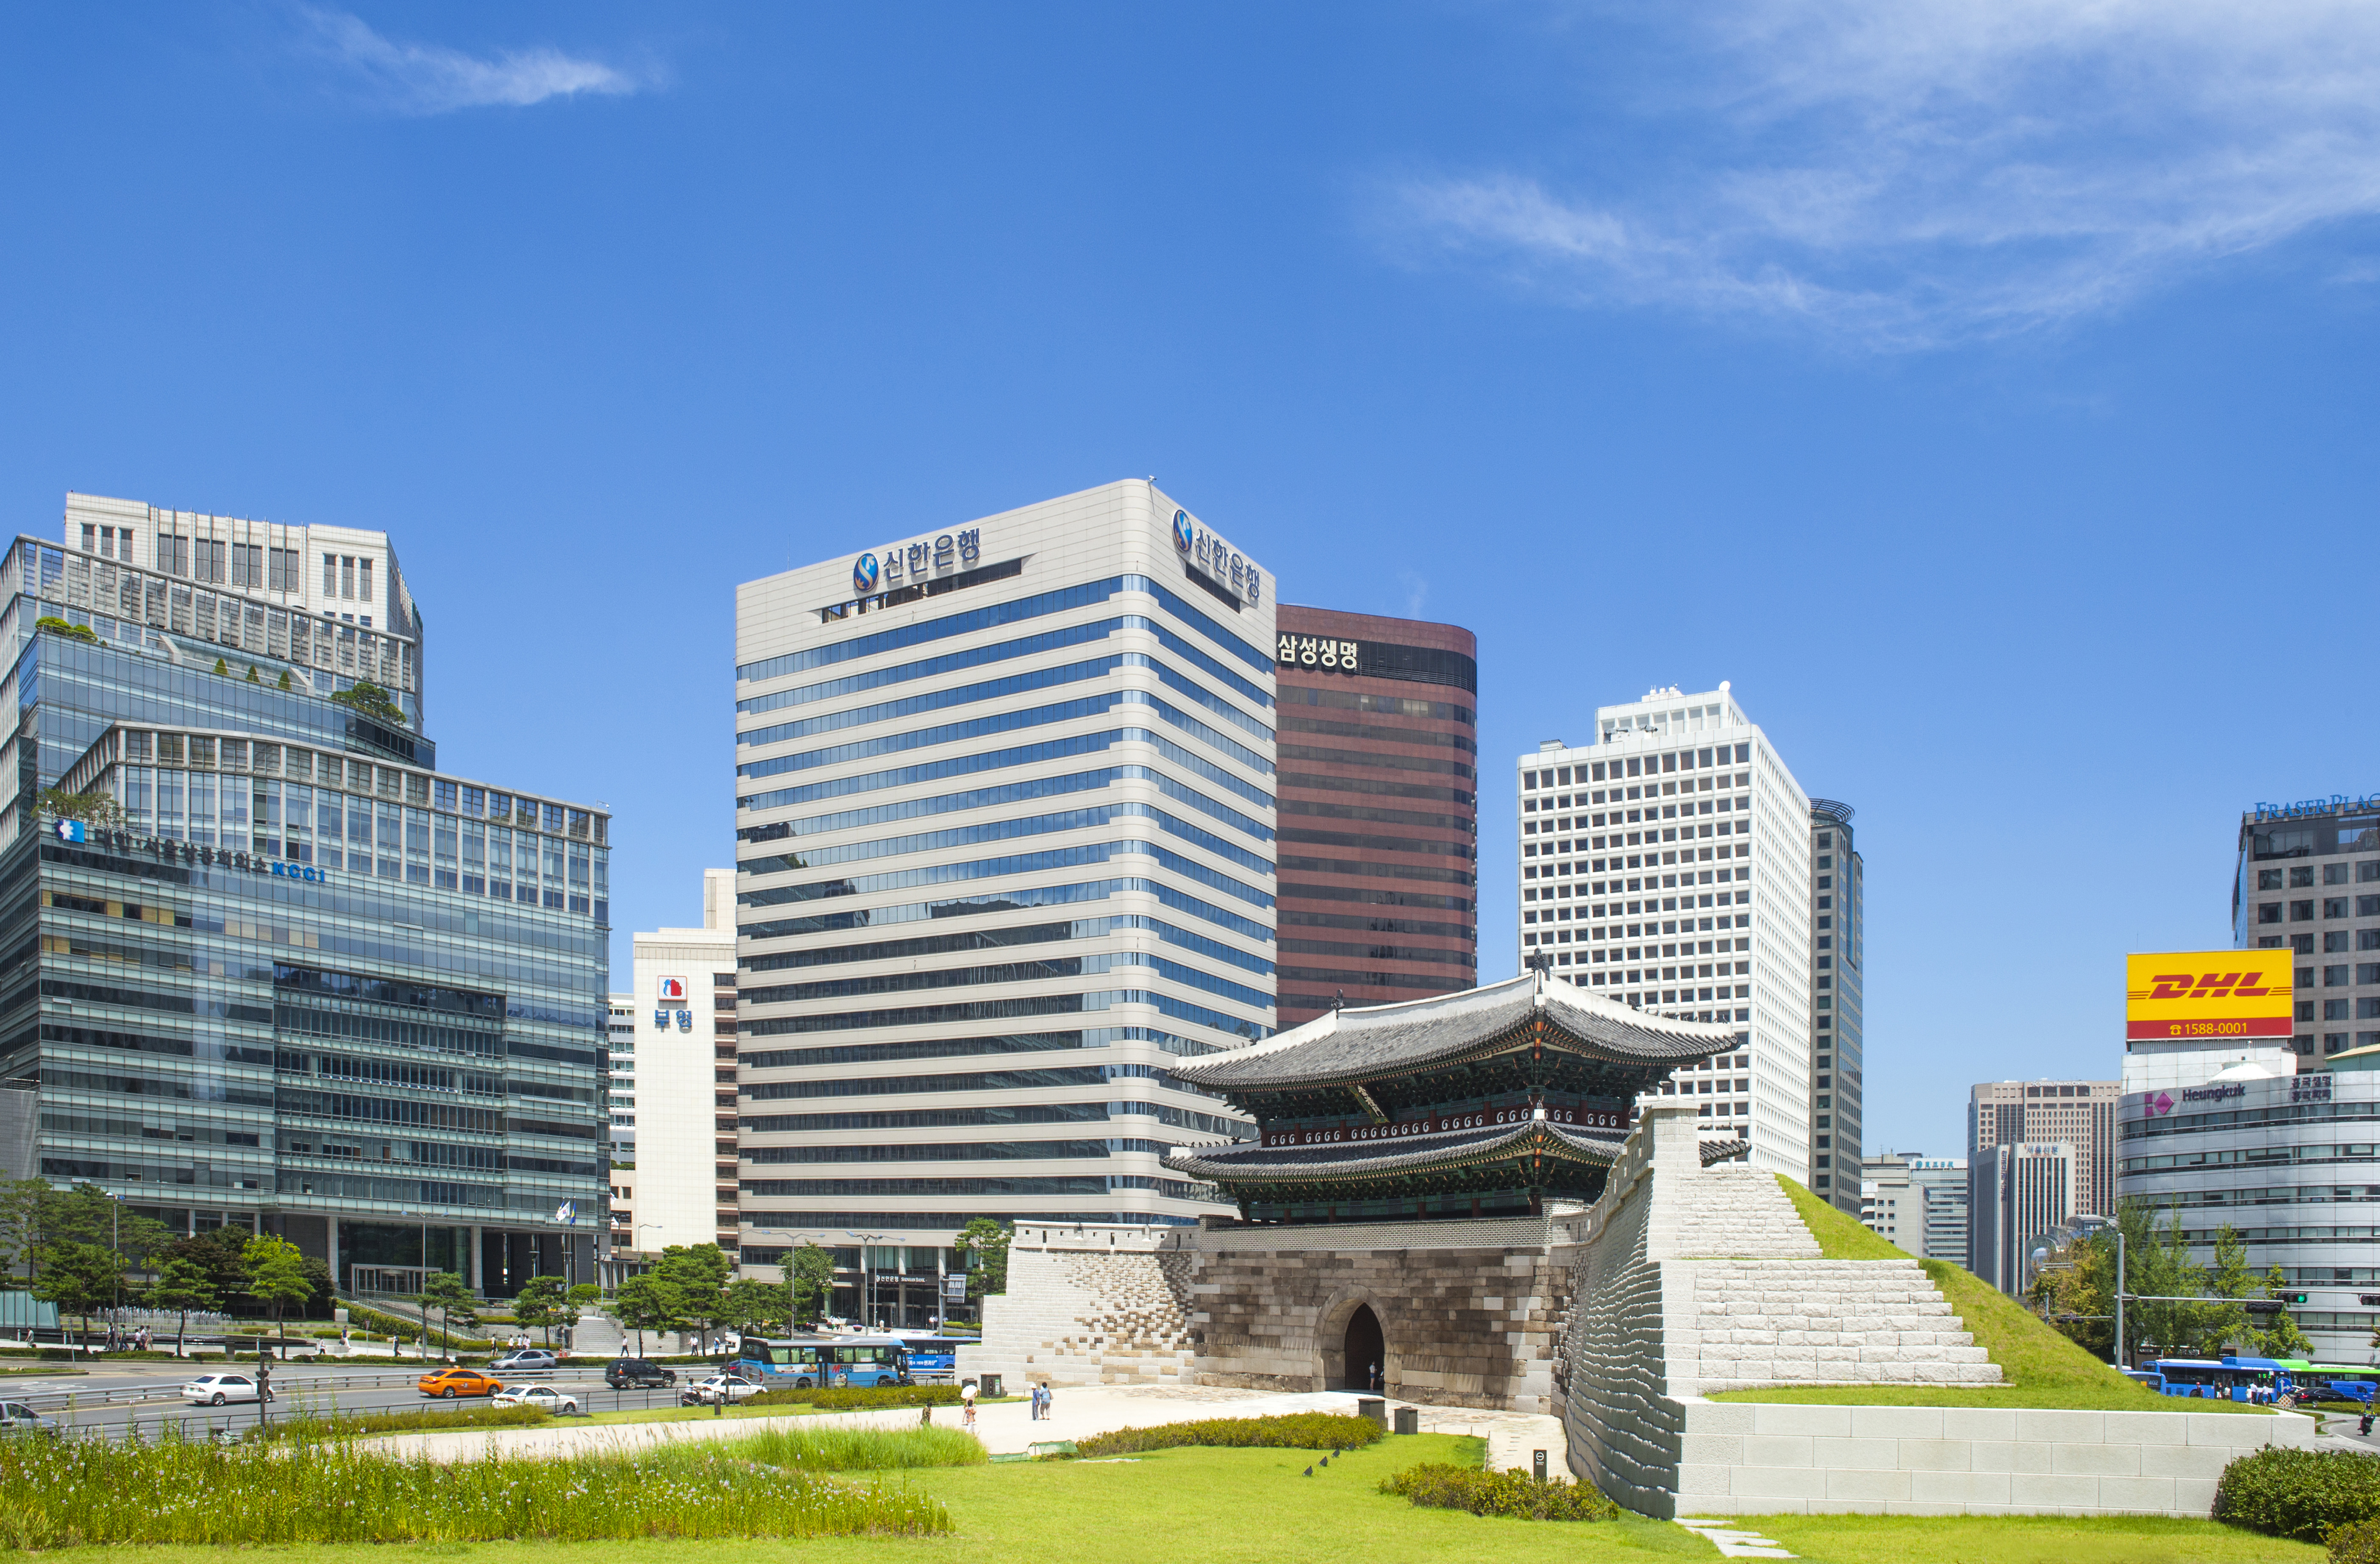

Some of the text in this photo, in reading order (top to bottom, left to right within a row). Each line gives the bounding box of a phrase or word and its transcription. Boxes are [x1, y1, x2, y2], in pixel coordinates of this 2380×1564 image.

[883, 527, 980, 579] 신한은행
[1196, 528, 1260, 600] 신한은행
[1278, 635, 1357, 669] 삼성생명
[273, 861, 325, 883] KCCI
[2149, 972, 2271, 999] DHL
[654, 1010, 692, 1027] 부영
[2185, 1022, 2247, 1035] 1588-0001
[2291, 1075, 2331, 1088] 흥국생명
[2183, 1083, 2245, 1102] Heungkuk
[2026, 1145, 2058, 1155] 서울신문
